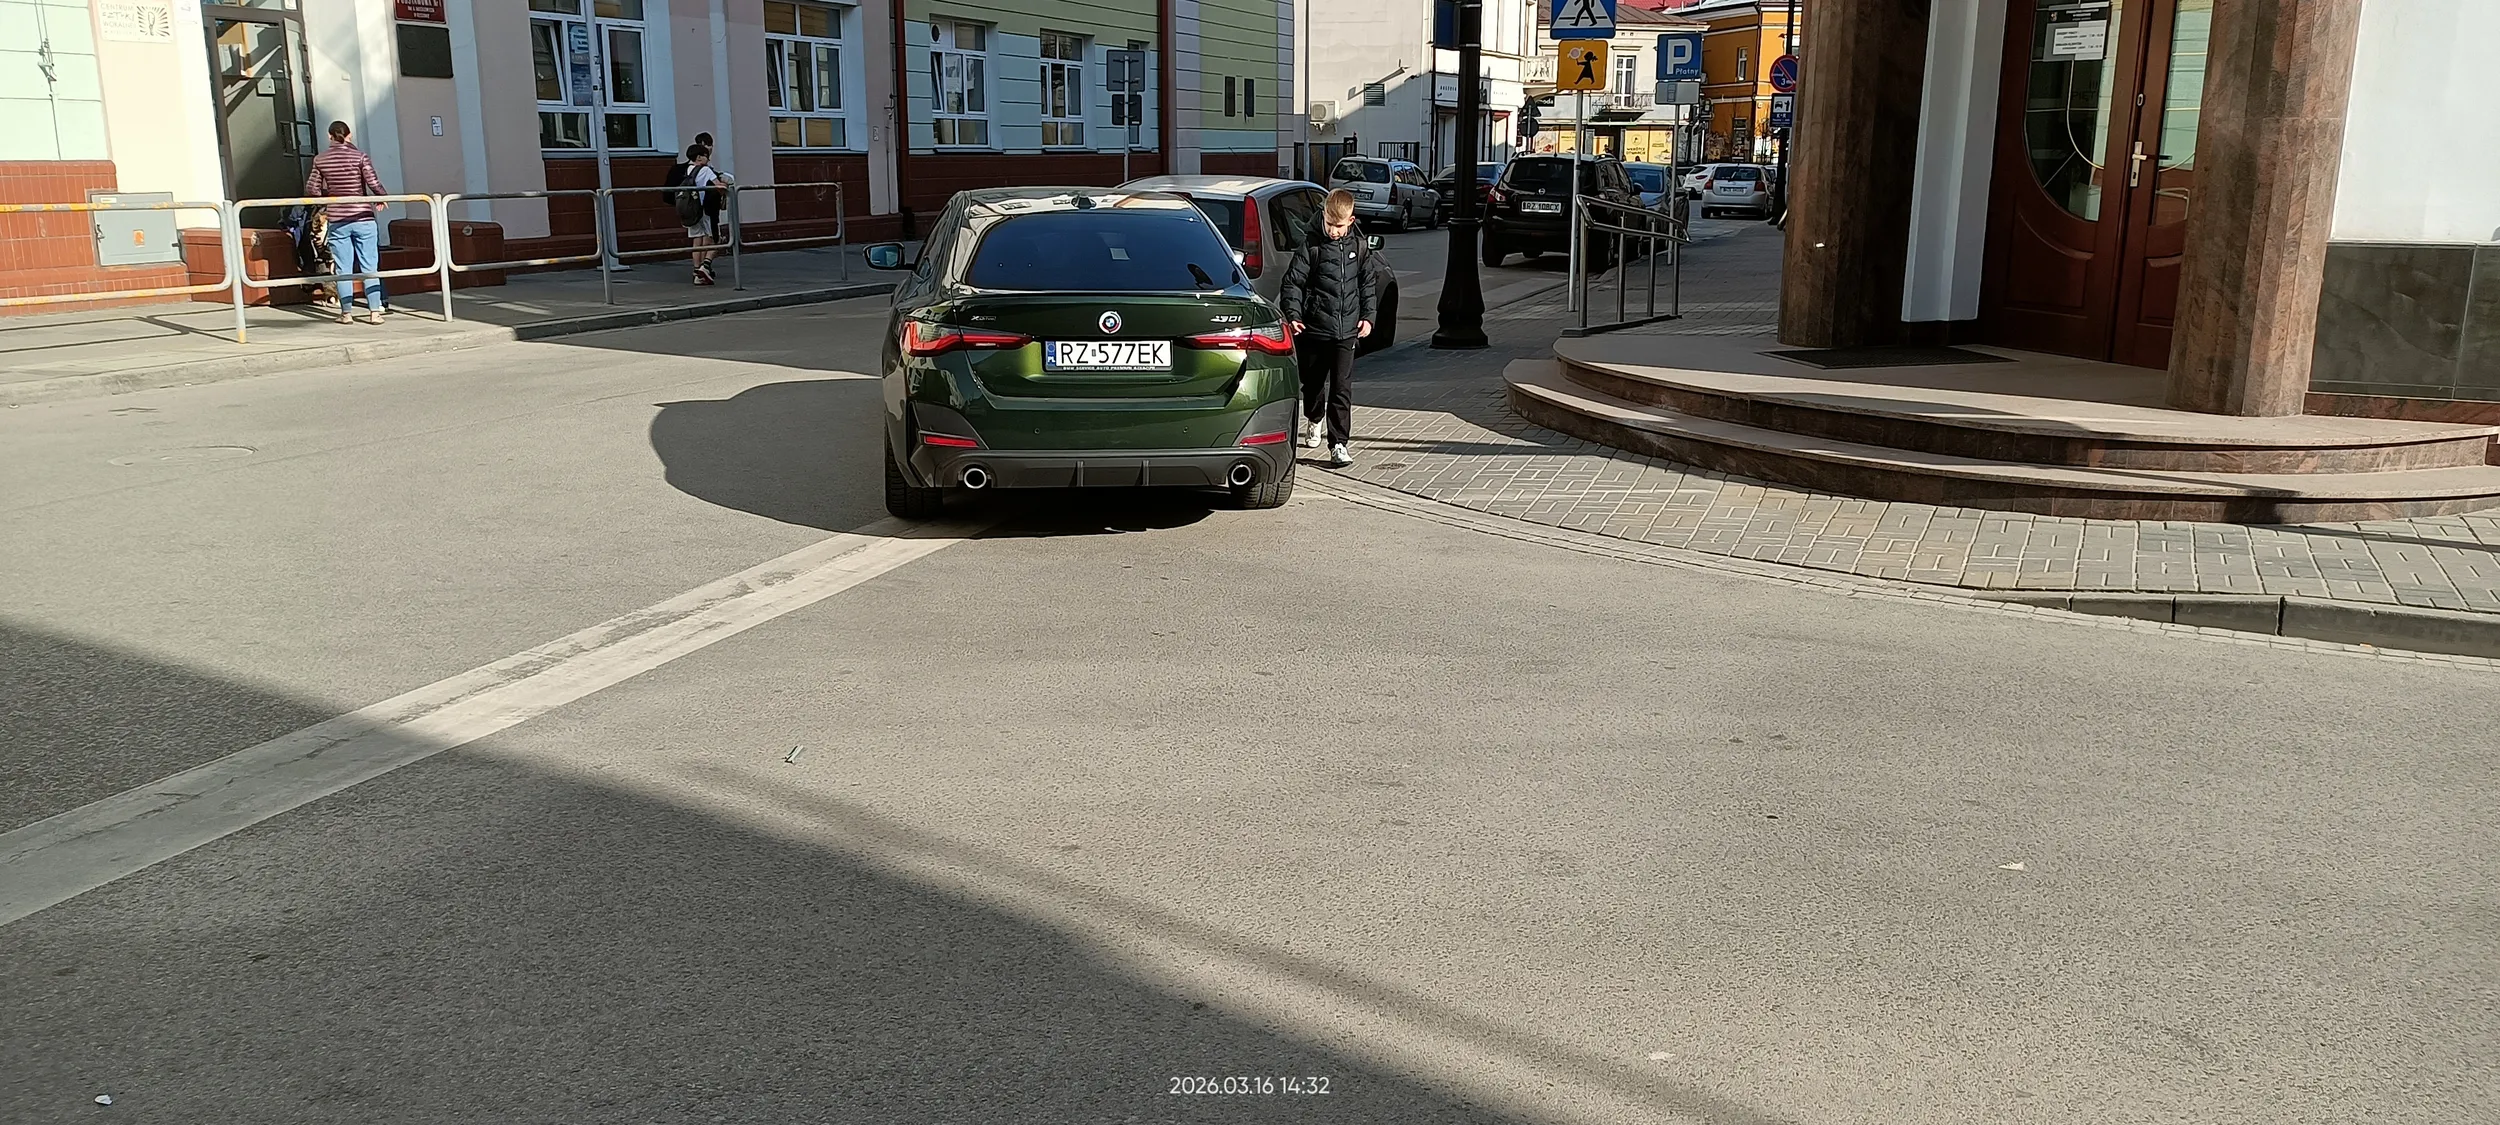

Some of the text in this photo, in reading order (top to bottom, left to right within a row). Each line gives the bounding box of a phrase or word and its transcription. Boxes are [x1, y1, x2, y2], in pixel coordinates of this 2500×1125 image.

[100, 3, 133, 11] CENTRUM
[1667, 39, 1692, 74] P
[1675, 67, 1699, 76] Płatny
[1061, 343, 1164, 364] RZ 577EK
